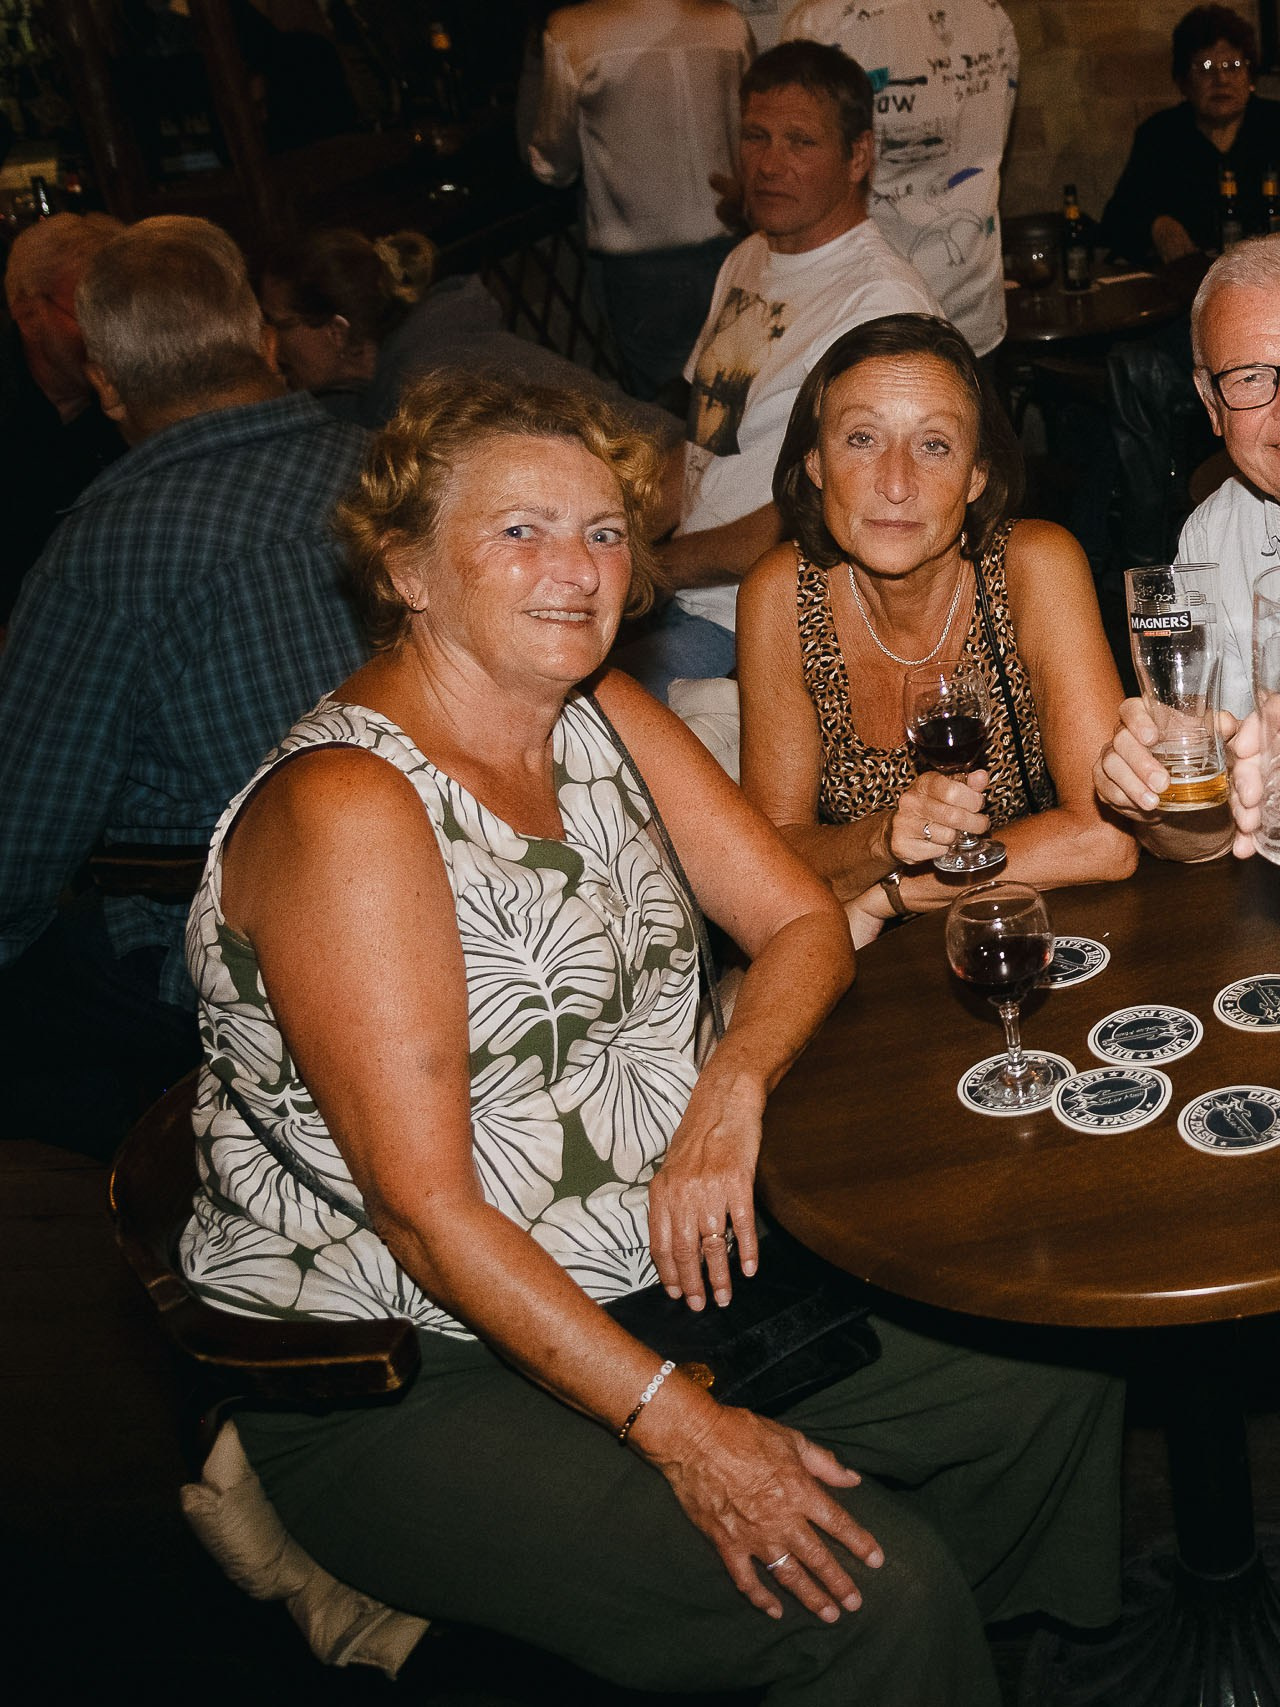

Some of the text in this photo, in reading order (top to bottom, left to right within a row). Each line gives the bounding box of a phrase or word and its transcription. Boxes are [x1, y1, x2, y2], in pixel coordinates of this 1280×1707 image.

[1131, 615, 1189, 629] MAGNERS
[1066, 1069, 1153, 1091] CAFE BAR
[1076, 1108, 1148, 1125] EL PASO
